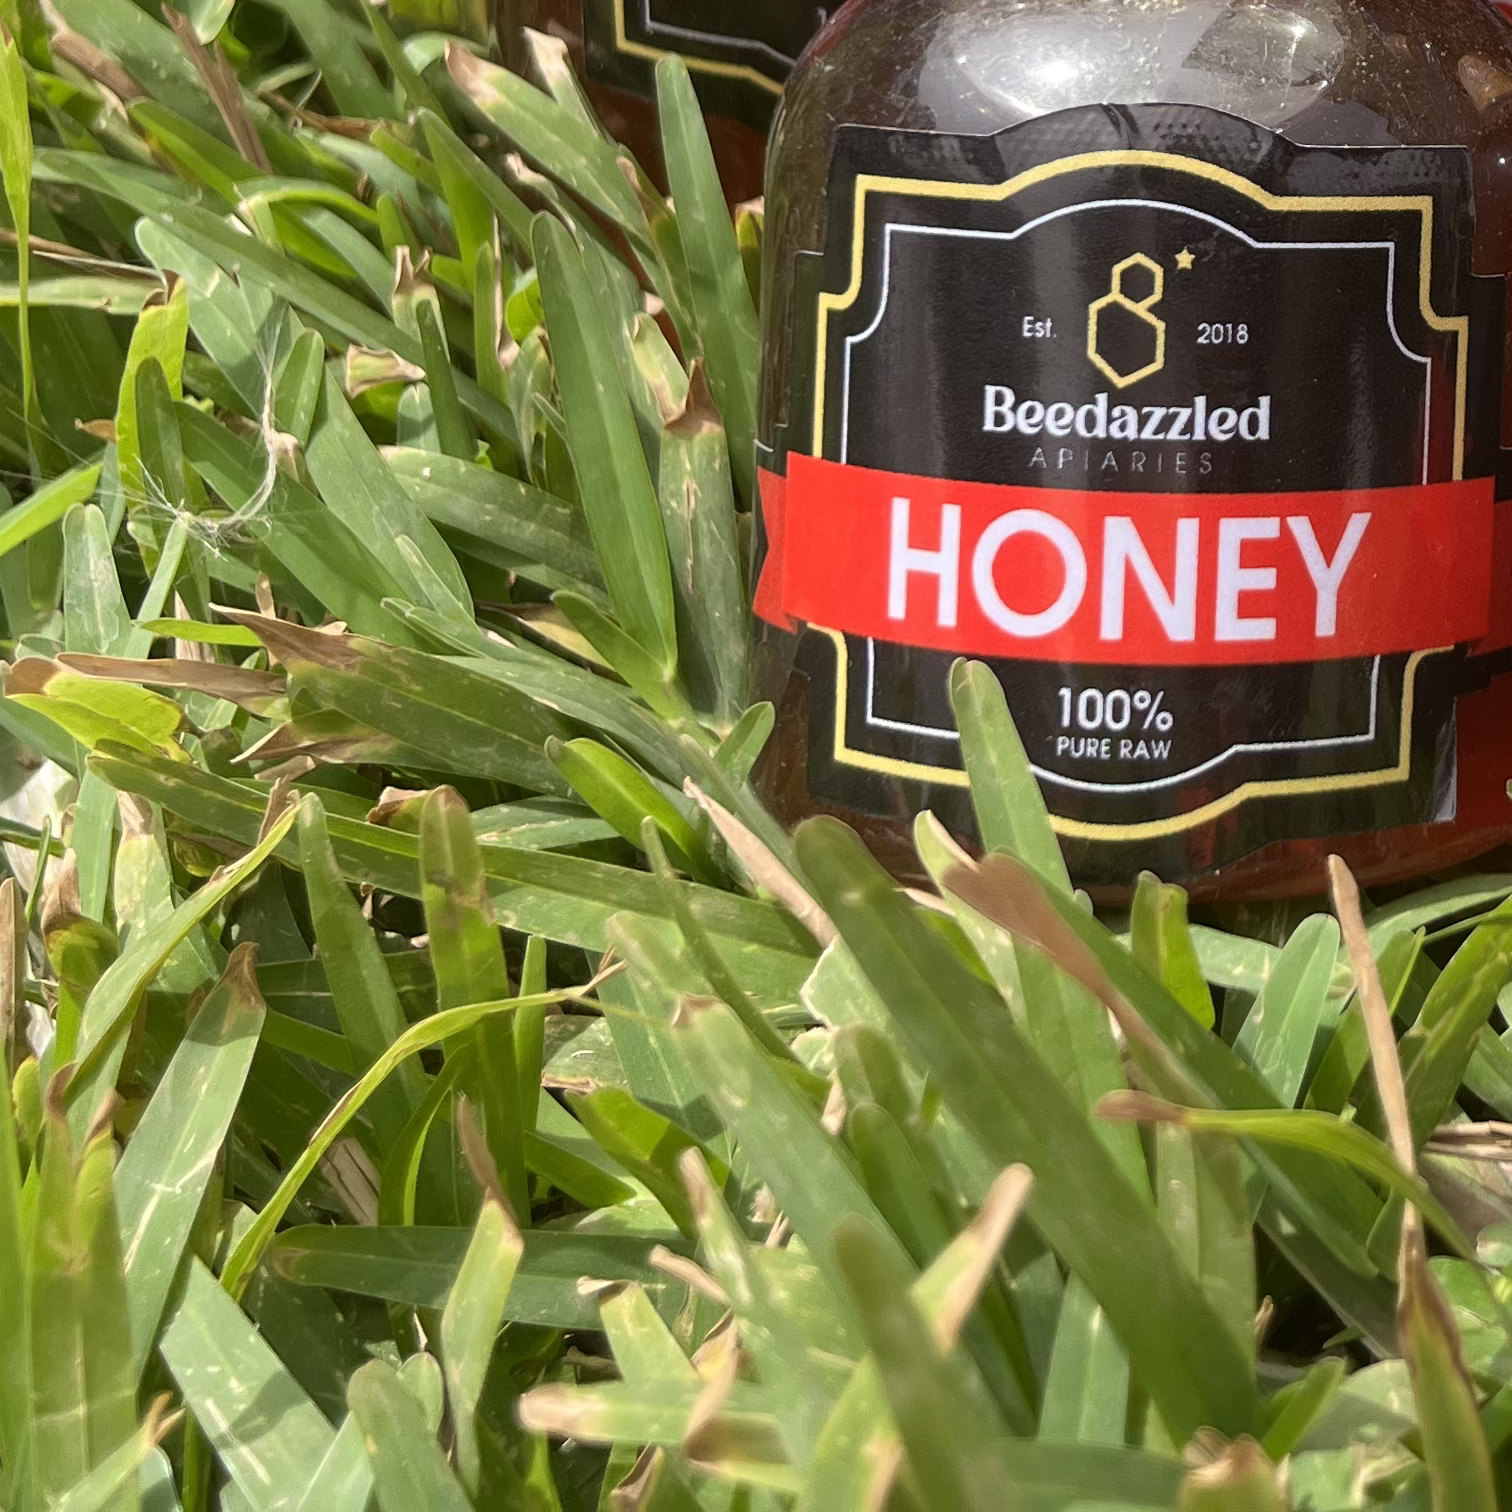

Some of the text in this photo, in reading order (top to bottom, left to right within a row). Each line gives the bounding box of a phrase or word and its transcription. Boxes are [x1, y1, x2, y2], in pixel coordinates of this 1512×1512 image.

[1021, 315, 1250, 346] Est. 2018
[982, 384, 1272, 443] Beedazzled
[1030, 446, 1214, 475] APIARIES
[886, 496, 1373, 644] HONEY
[1057, 685, 1174, 734] 100%
[1056, 734, 1173, 761] PURE RAW
